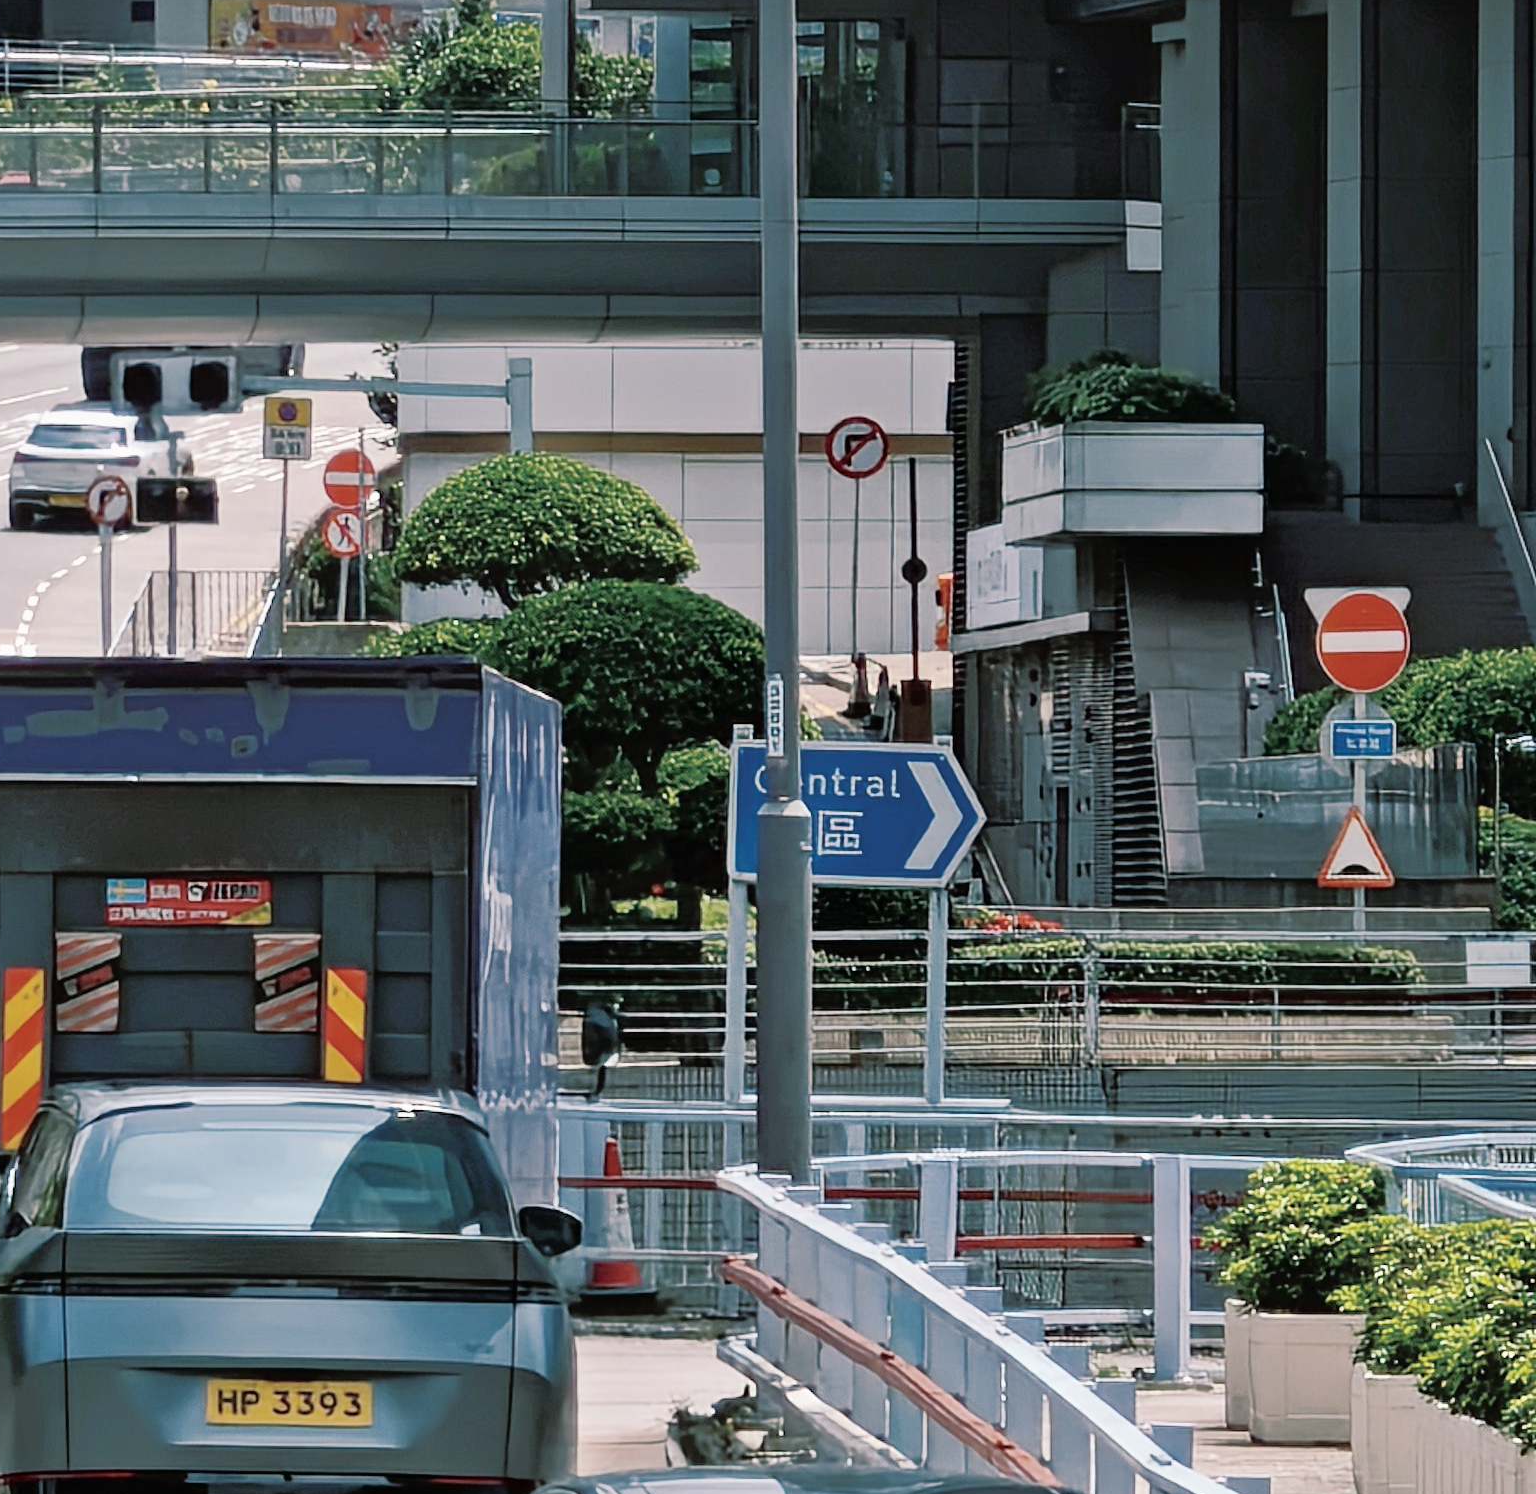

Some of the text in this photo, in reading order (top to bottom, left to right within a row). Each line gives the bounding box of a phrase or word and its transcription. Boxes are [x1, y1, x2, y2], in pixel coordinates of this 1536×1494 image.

[755, 763, 901, 799] Cntral
[217, 1389, 362, 1416] HP 3393
